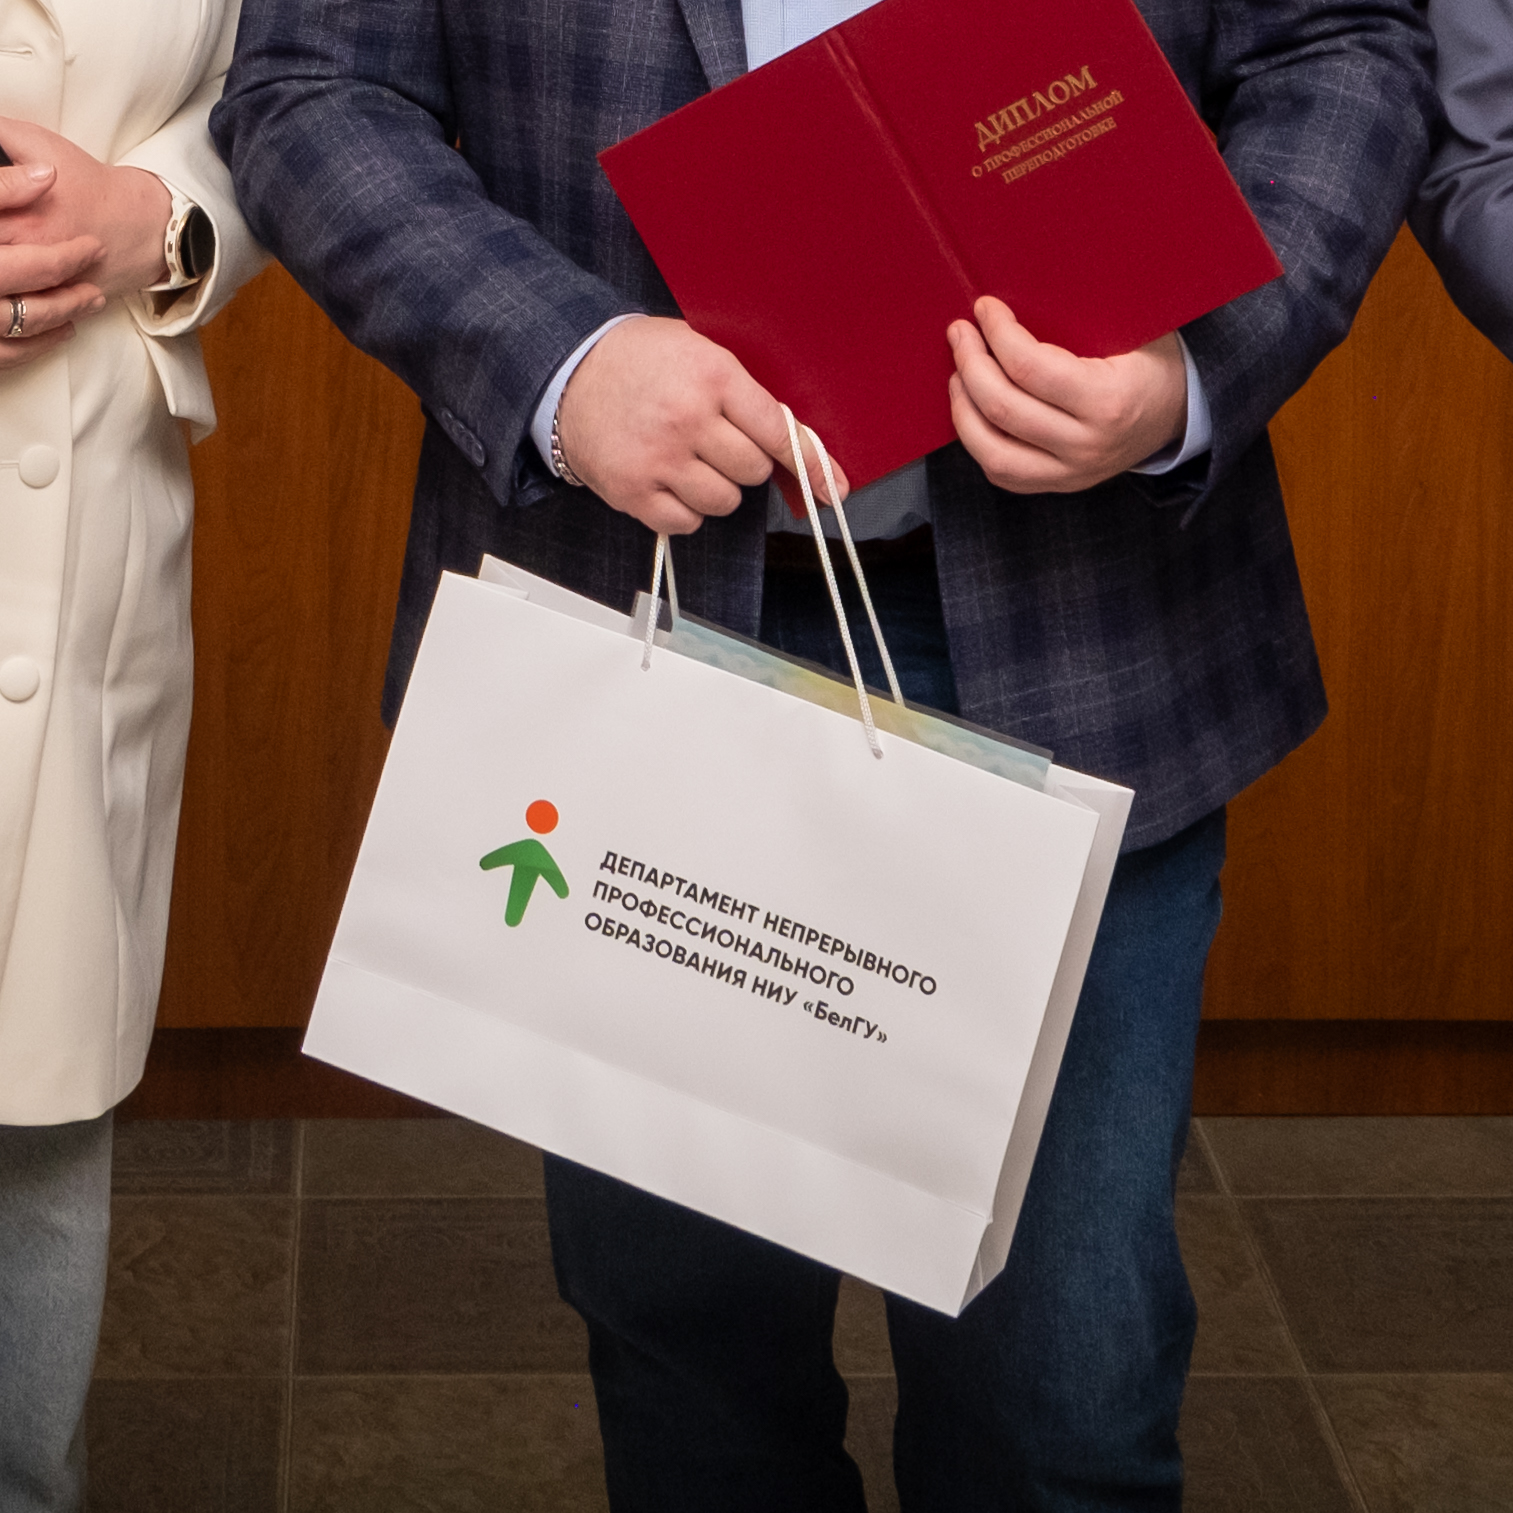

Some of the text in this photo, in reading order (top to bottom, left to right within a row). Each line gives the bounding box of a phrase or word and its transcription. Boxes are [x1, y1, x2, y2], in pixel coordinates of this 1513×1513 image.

[971, 89, 1126, 177] О ПРОФЕССИОНАЛЬНОЙ
[974, 65, 1098, 153] ДИПЛОМ
[1001, 116, 1118, 185] ПЕРЕПОДГОТОВКЕ
[592, 880, 856, 996] ПРОФЕССИОНАЛЬНОГО
[599, 850, 938, 996] ДЕПАРТАМЕНТ НЕПРЕРЫВНОГО
[584, 912, 889, 1045] ОБРАЗОВАНИЯ НИУ «БелГУ»
